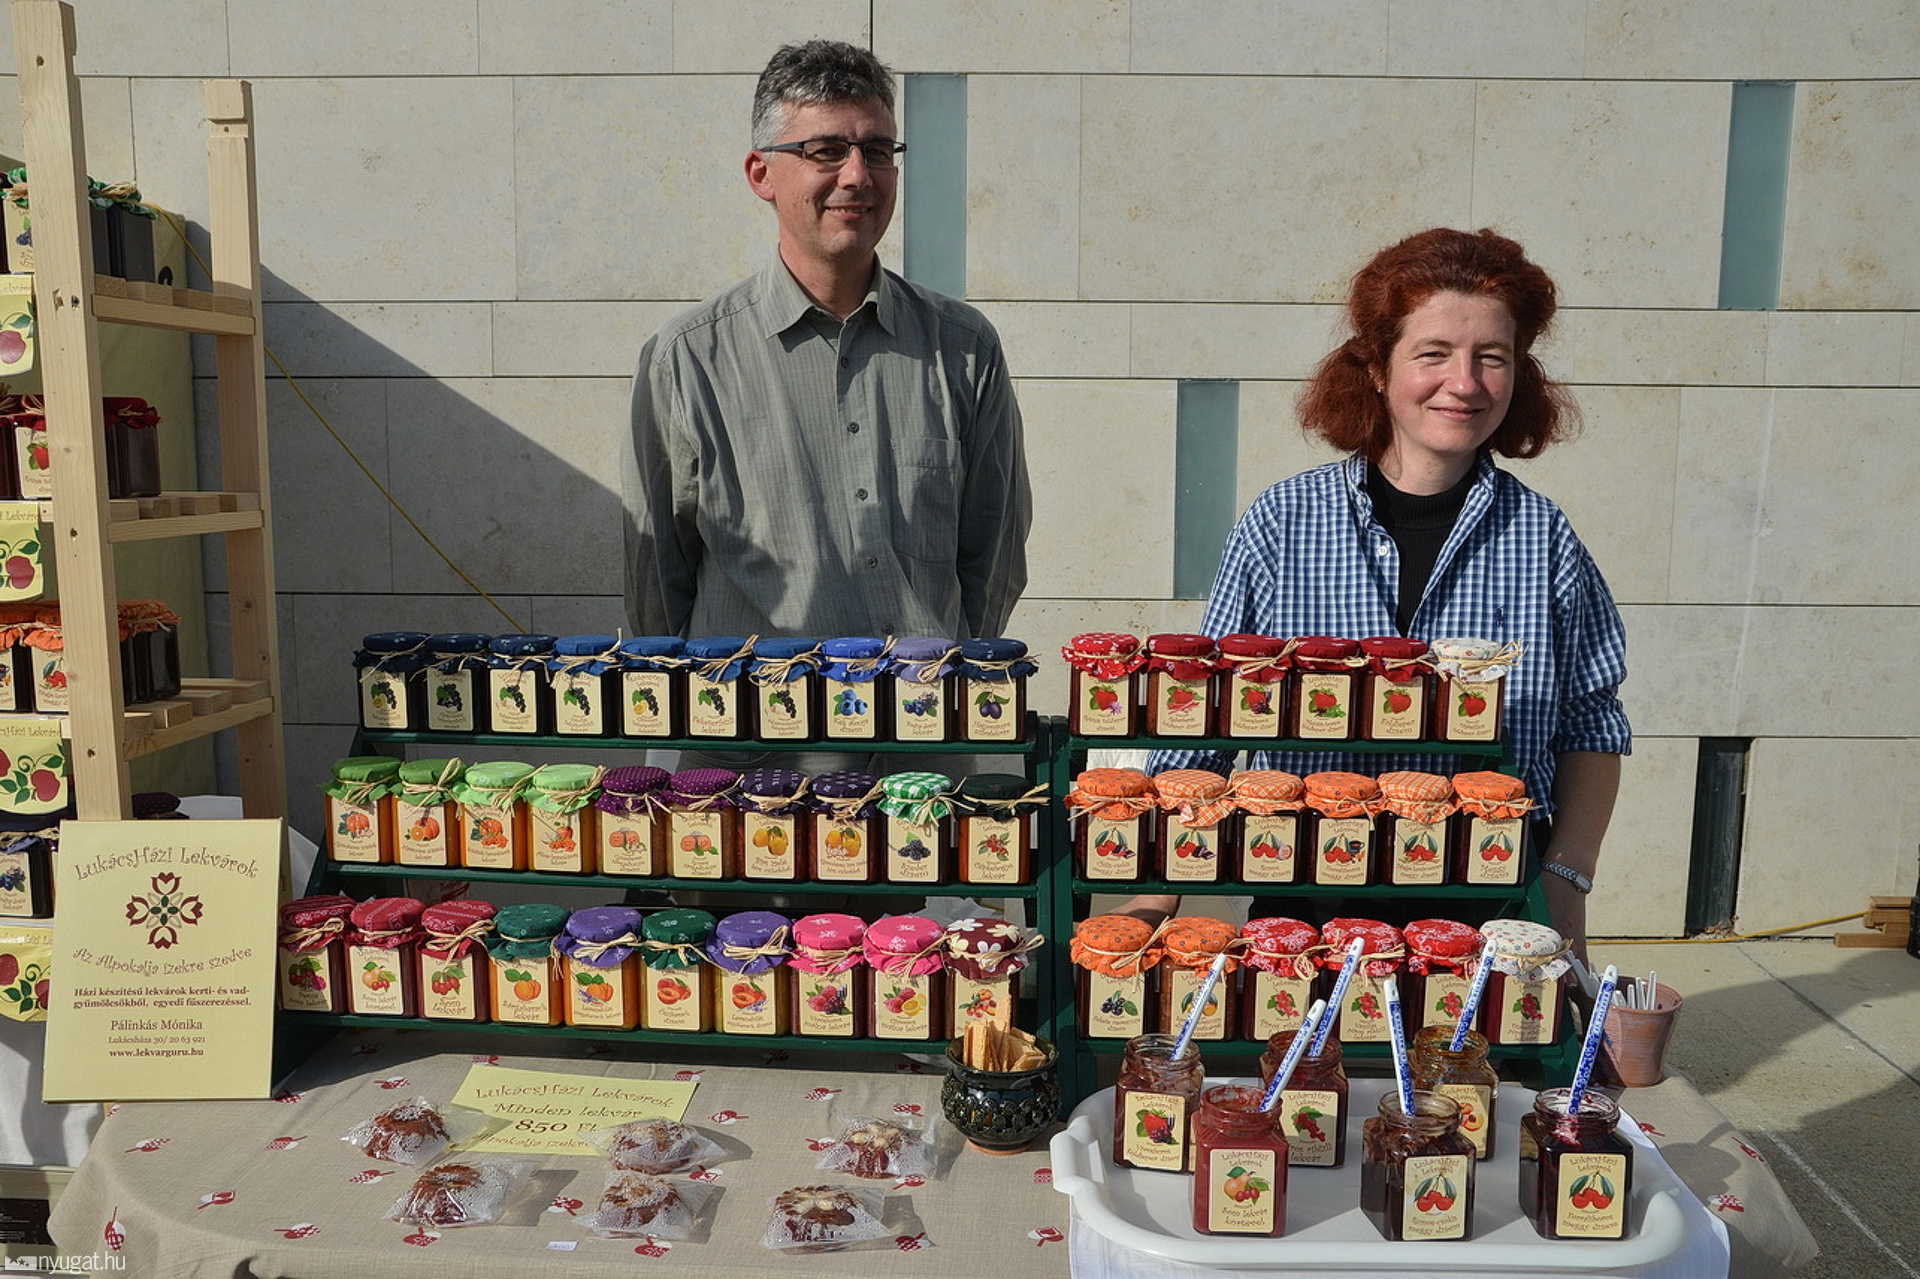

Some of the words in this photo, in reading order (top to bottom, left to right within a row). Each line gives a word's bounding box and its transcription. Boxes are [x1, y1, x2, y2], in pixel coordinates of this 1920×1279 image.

[180, 846, 260, 879] Lekvárok
[145, 986, 187, 996] lekvárok
[111, 1019, 158, 1031] Pálinkás
[161, 1018, 203, 1031] Mónika
[109, 1047, 204, 1058] www.lekvarguru.hu
[494, 1103, 572, 1116] Minden
[515, 1119, 568, 1134] 850
